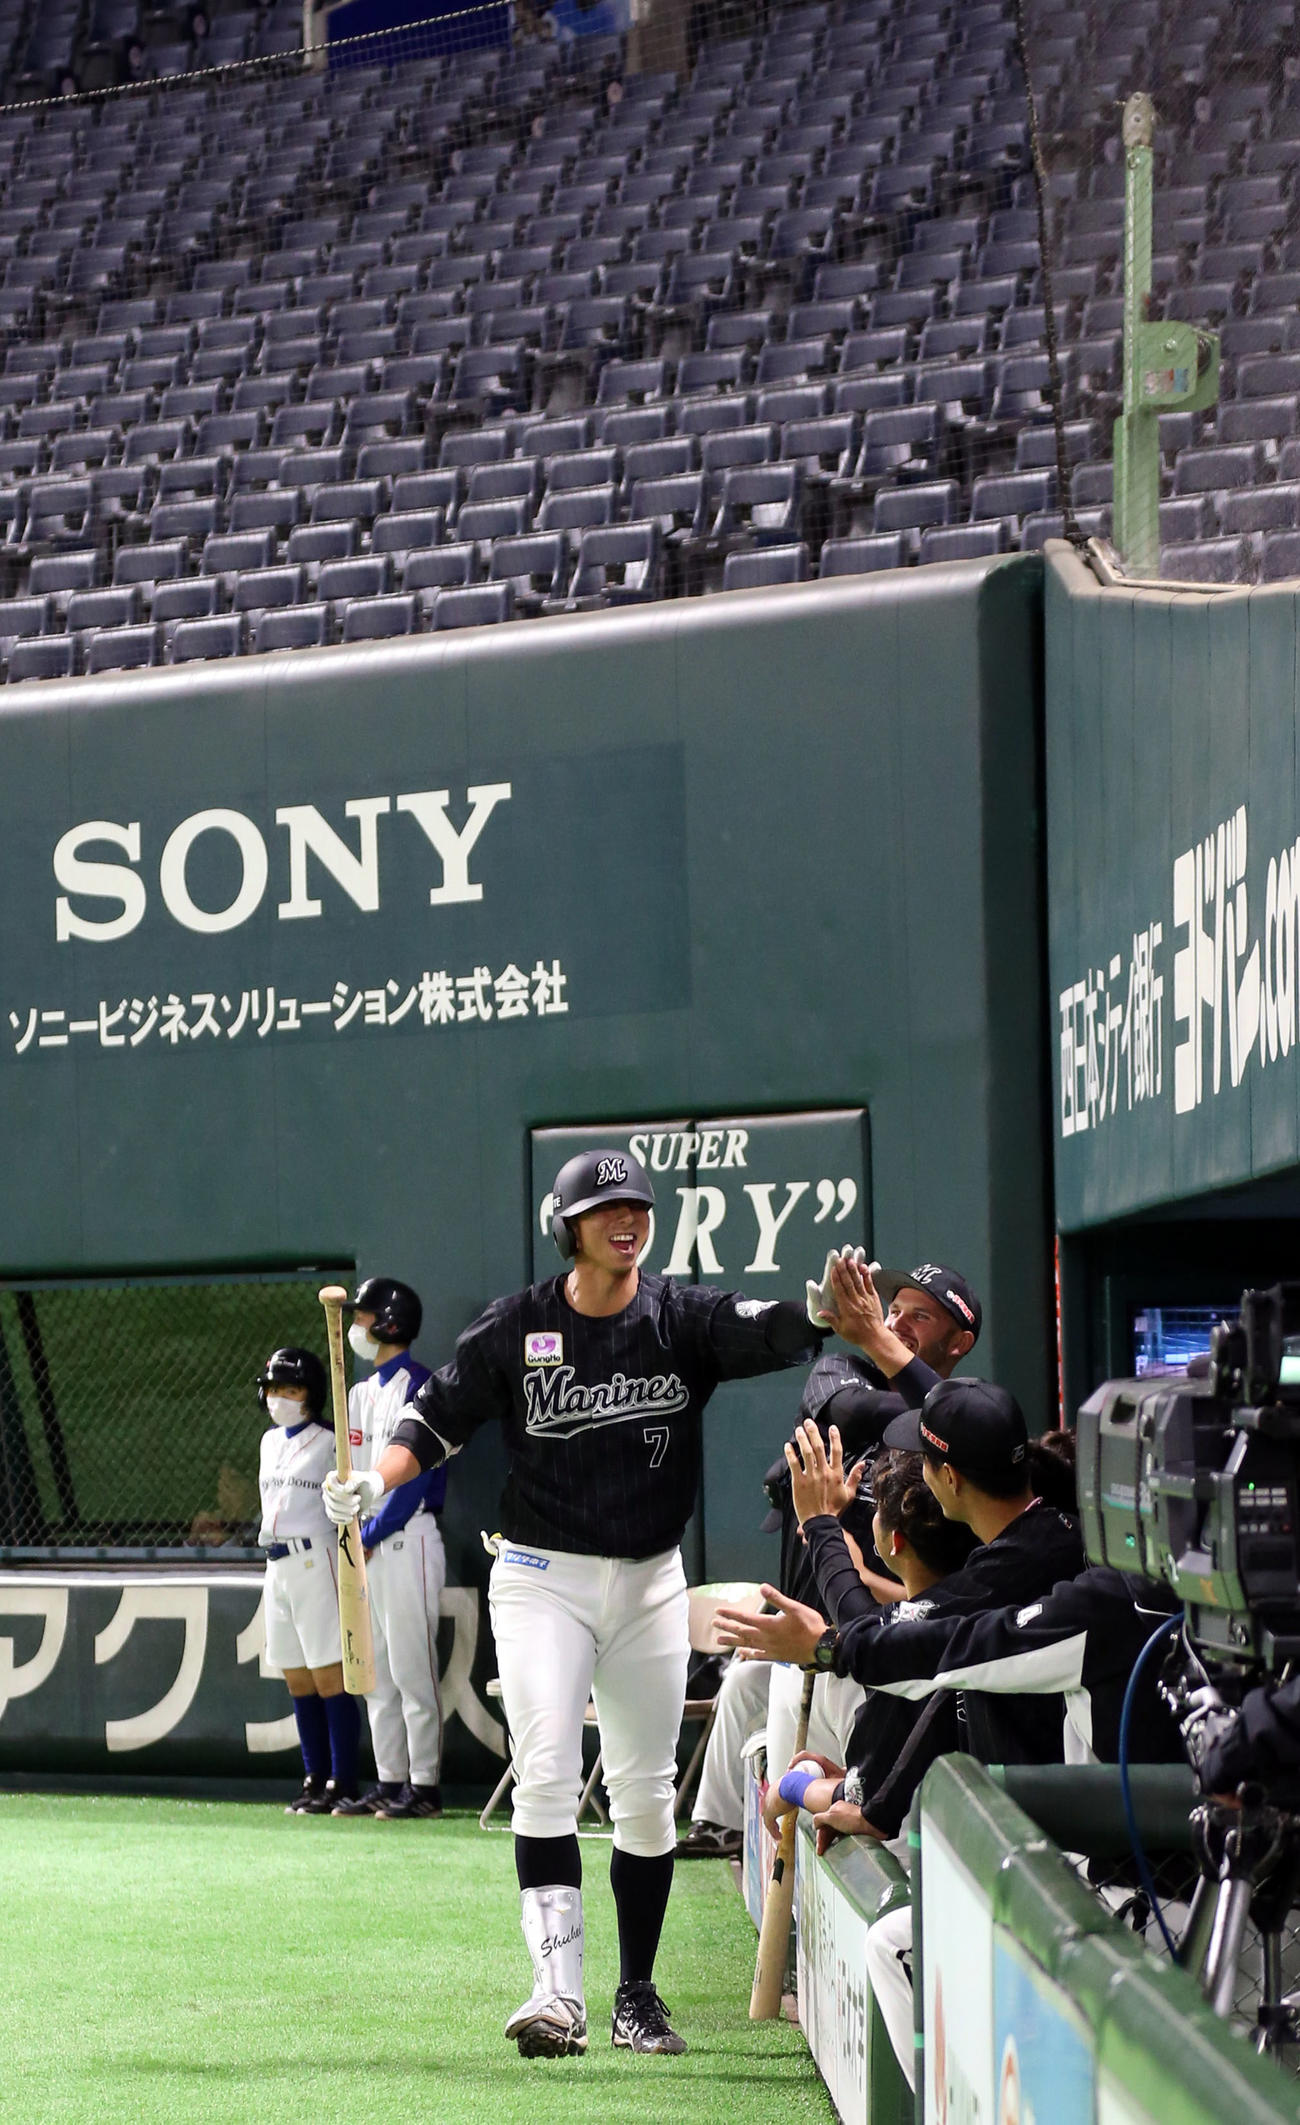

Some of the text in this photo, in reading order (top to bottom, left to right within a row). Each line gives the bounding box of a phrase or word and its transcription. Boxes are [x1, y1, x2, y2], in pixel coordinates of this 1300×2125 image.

[52, 782, 512, 942] SONY
[9, 959, 569, 1054] ソニービジネスソリューション株式会社
[629, 1128, 749, 1171] SUPER
[523, 1365, 689, 1426] Marines
[643, 1426, 669, 1468] 7
